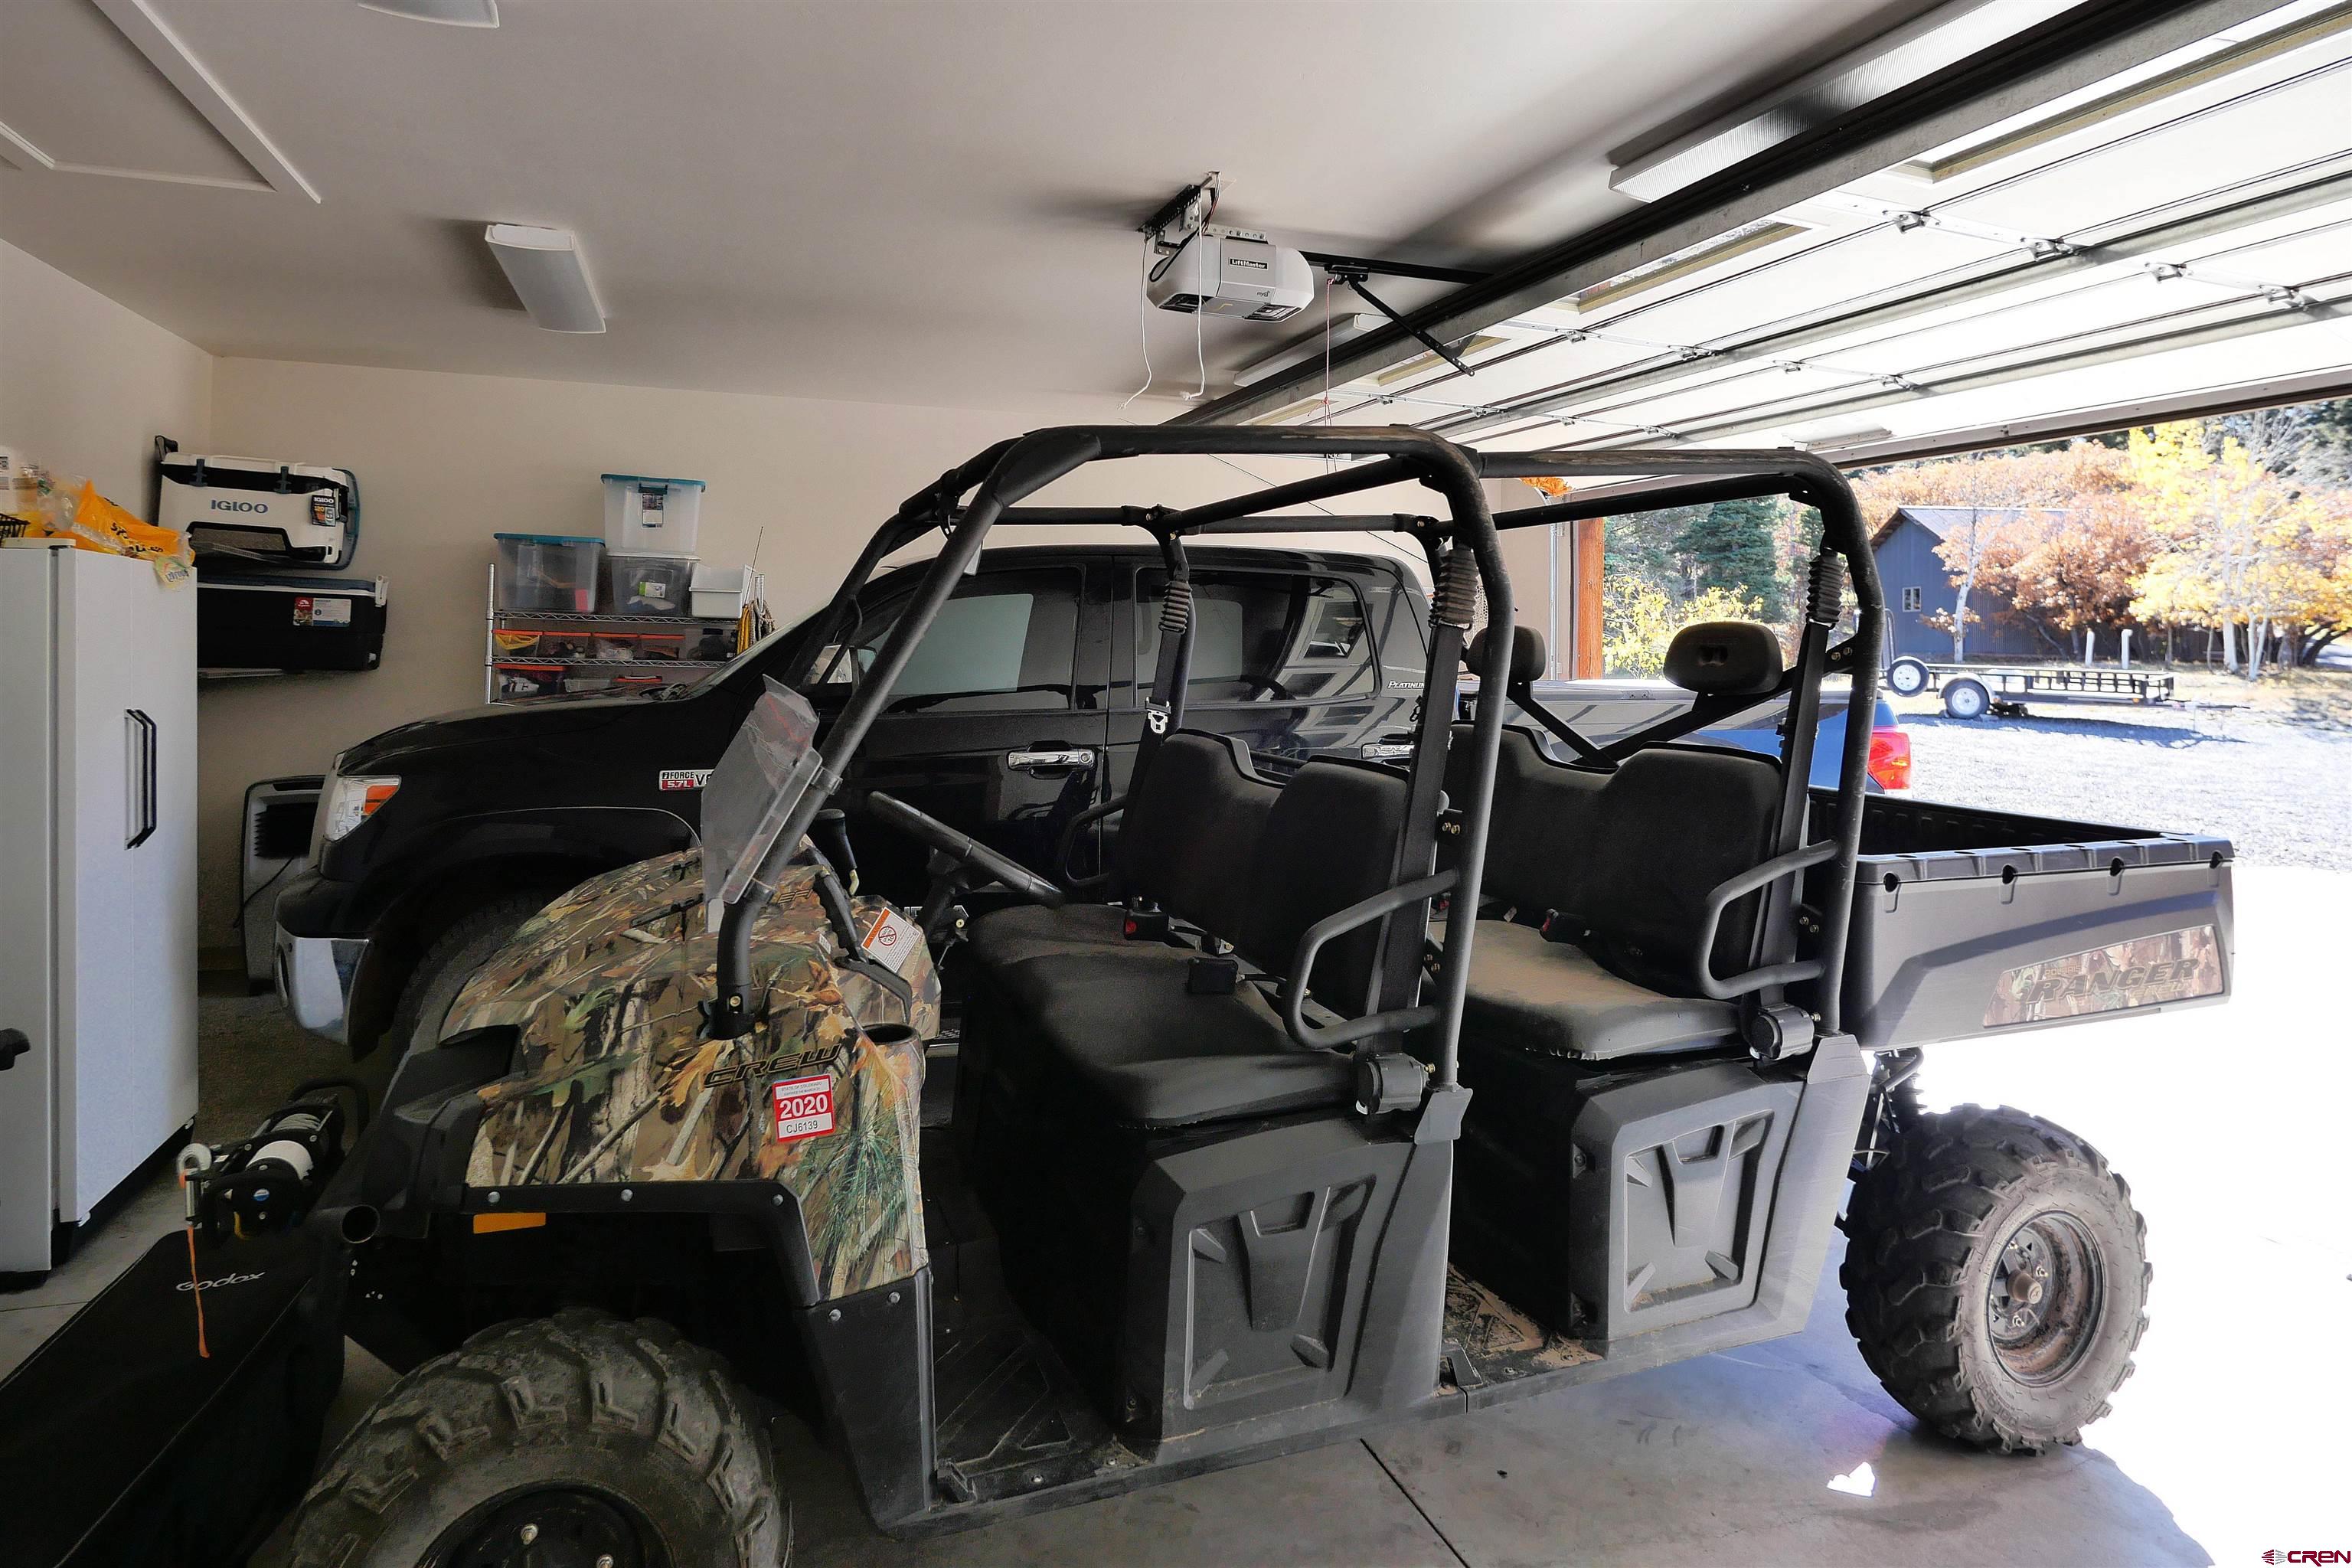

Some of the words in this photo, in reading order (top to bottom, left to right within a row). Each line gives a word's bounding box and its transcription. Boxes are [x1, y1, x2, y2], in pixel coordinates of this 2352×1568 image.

[211, 499, 269, 514] IGLOO
[667, 780, 691, 789] 5.7L
[2026, 958, 2200, 1004] RANGER
[704, 1043, 843, 1089] CREW
[779, 1094, 828, 1119] 2020
[786, 1120, 818, 1134] CJ6139
[176, 1272, 266, 1291] Godox
